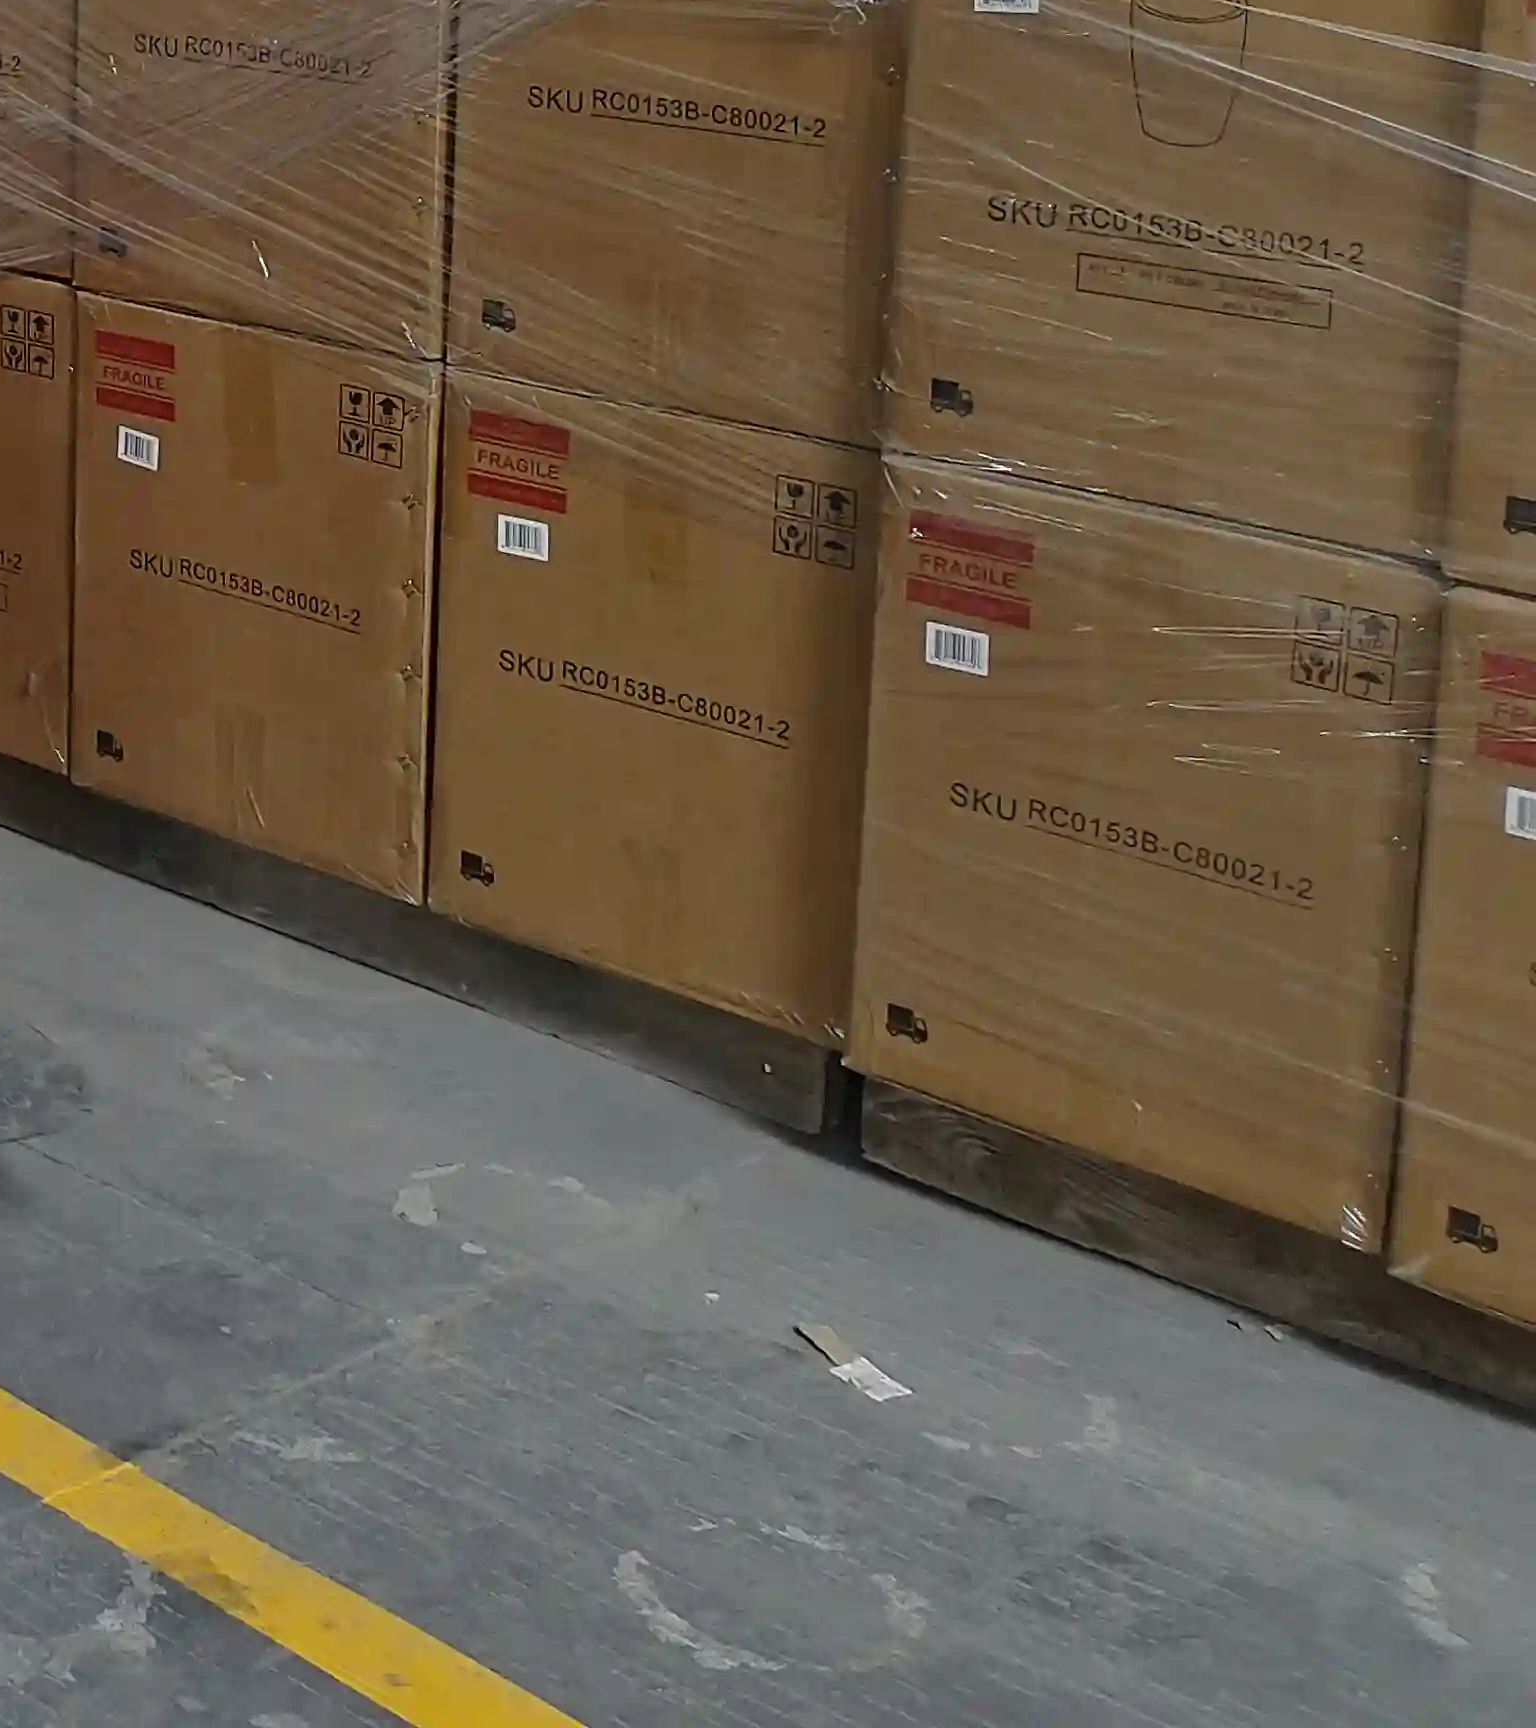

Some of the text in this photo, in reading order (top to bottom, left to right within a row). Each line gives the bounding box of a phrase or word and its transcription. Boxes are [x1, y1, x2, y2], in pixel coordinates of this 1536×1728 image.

[133, 32, 180, 60] SKU
[528, 85, 826, 139] SKU RC0153B-C80021-2
[986, 194, 1366, 266] SKU RC0153B-C80021-2
[102, 366, 165, 391] FRAGILE
[476, 448, 560, 481] FRAGILE
[130, 548, 362, 628] SKU RC0153B-C80021-2
[918, 552, 1018, 591] FRAGILE
[498, 648, 791, 742] SKU RC0153B-C80021-2
[949, 781, 1315, 901] SKU RC0153B-C80021-2
